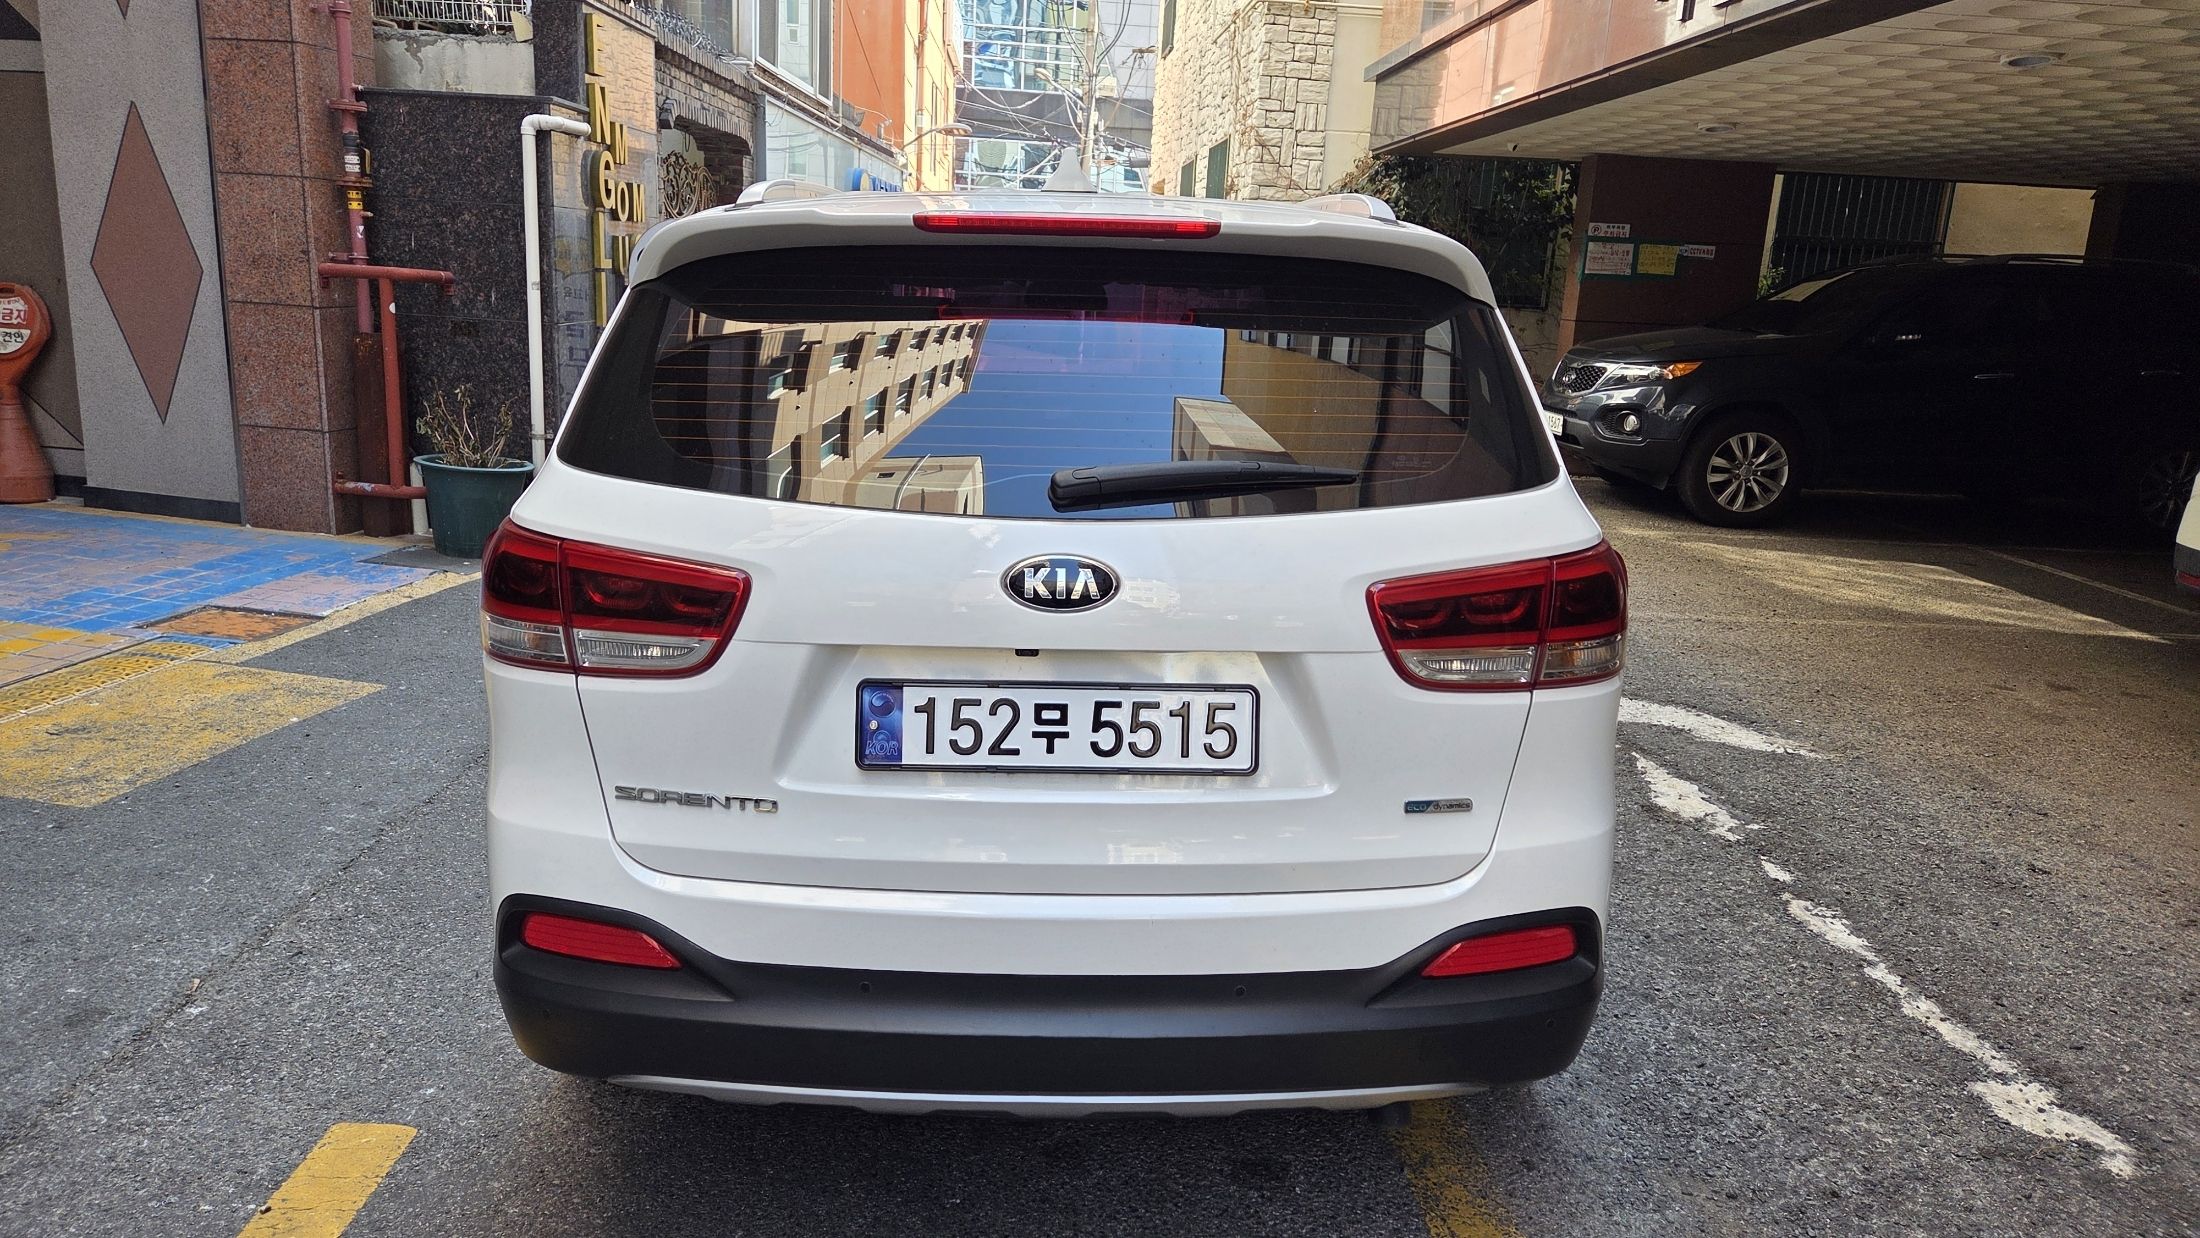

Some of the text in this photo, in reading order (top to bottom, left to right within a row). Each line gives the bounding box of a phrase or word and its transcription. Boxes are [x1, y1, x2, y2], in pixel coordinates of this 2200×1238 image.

[1, 330, 24, 343] 견인
[1023, 567, 1101, 600] KIA
[914, 696, 1238, 760] 152무 5515
[865, 741, 899, 756] KOR
[614, 785, 779, 814] SORENTO
[1432, 802, 1472, 811] dynamics
